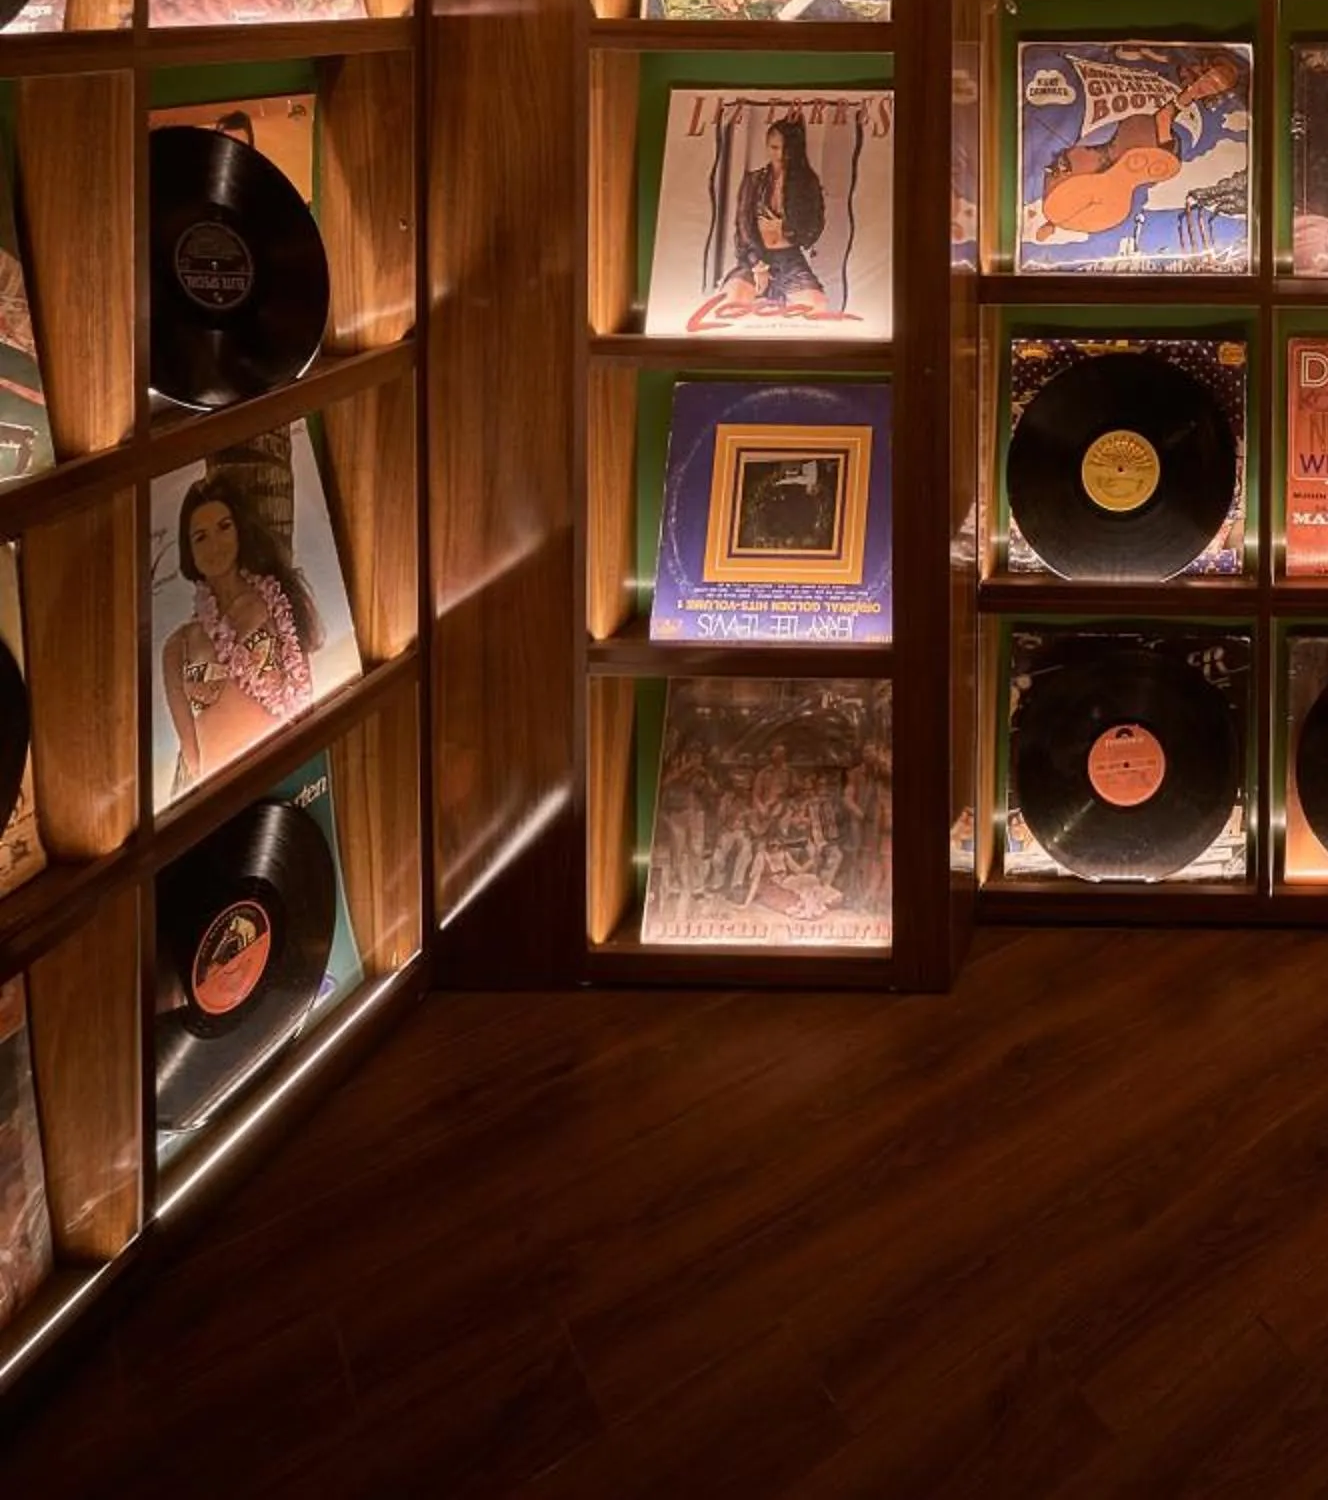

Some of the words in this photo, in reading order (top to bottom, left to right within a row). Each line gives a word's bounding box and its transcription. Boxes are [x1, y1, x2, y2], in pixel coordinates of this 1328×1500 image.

[770, 601, 823, 613] GOLDEN
[696, 613, 762, 639] LEWIS
[770, 614, 802, 638] LEE
[809, 613, 857, 640] JERRY
